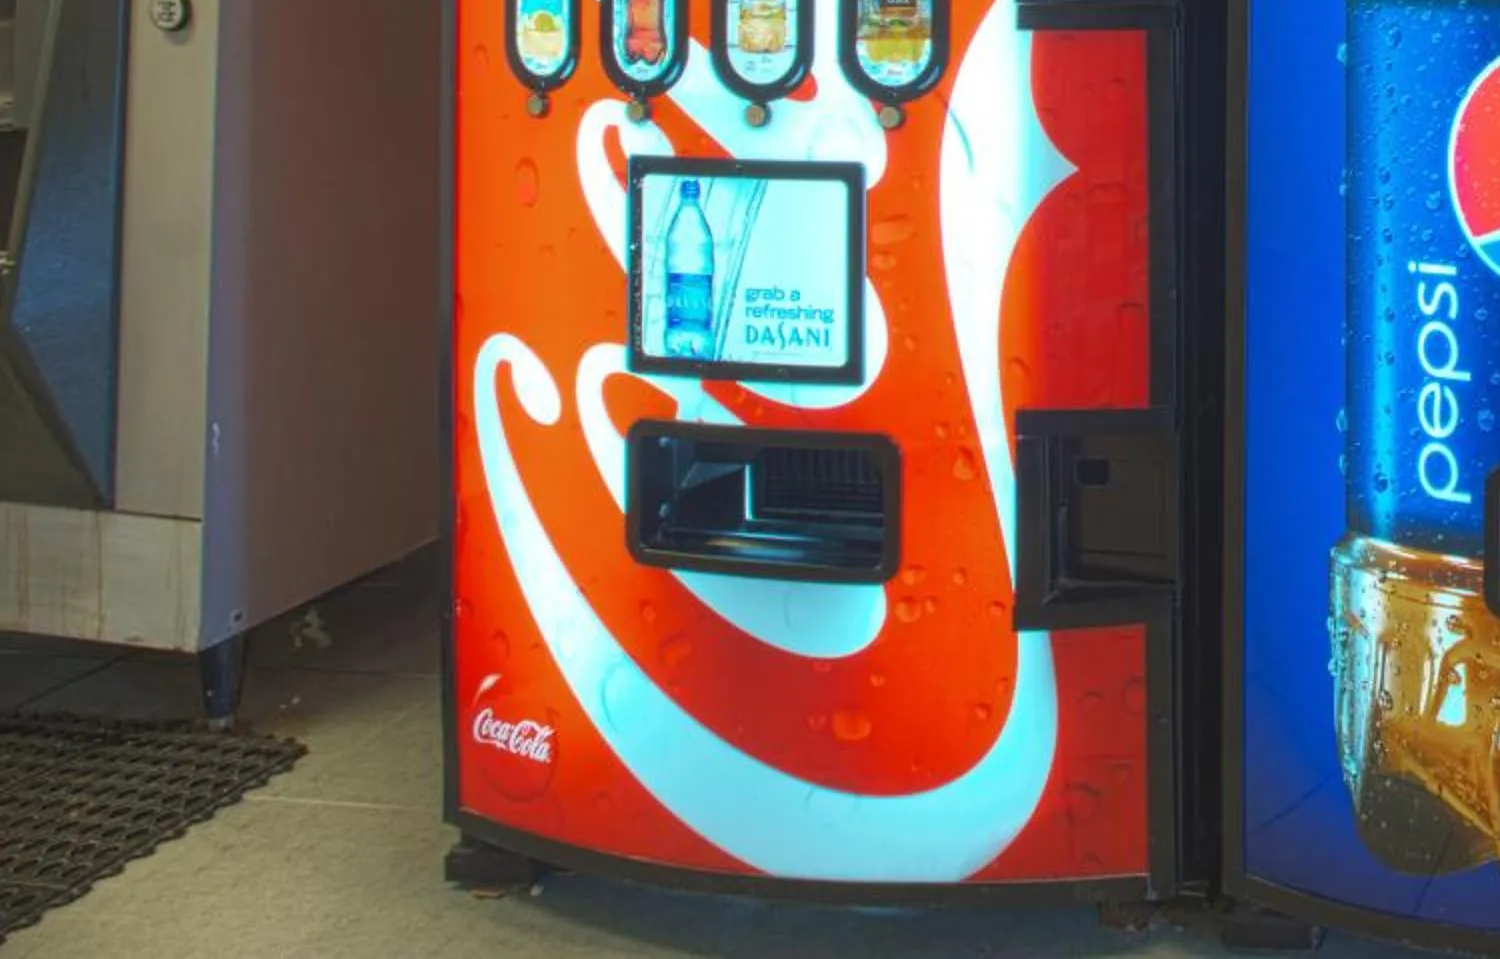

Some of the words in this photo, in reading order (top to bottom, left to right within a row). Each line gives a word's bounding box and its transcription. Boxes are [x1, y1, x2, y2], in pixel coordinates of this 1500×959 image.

[744, 287, 785, 304] grab
[789, 290, 801, 301] a
[745, 306, 835, 325] refreshing
[744, 322, 831, 350] DASANI
[1407, 260, 1472, 504] pepsi
[473, 707, 555, 764] Coca-Cola
